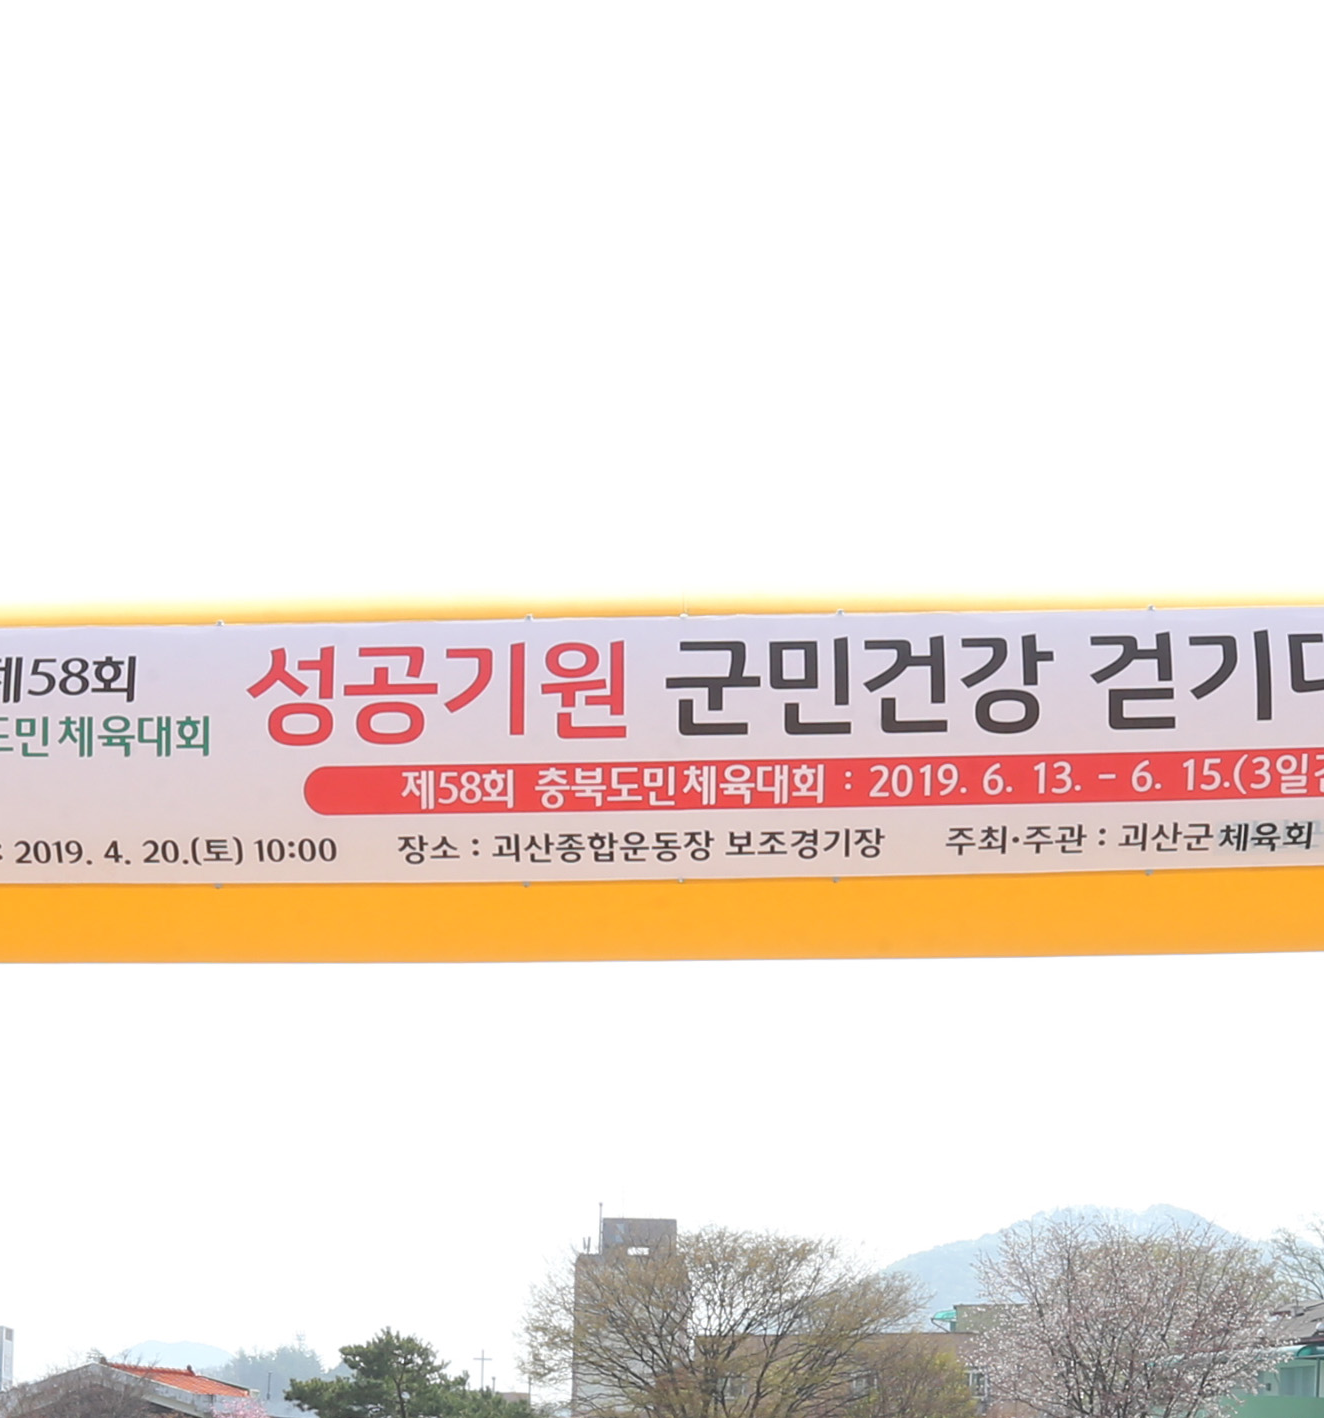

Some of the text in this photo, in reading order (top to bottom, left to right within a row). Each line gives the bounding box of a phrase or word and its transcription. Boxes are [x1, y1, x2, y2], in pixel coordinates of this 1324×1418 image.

[247, 640, 627, 747] 성공기원
[665, 632, 1055, 736] 군민건강
[400, 768, 515, 811] 제58회
[534, 763, 825, 807] 충북도민체육대회
[869, 763, 968, 798] 2019.
[981, 763, 1012, 796] 6.
[1033, 761, 1082, 794] 13.
[1131, 760, 1162, 792] 6.
[15, 839, 93, 866] 2019.
[104, 840, 132, 866] 4.
[252, 837, 337, 863] 10:00
[397, 833, 461, 865] 장소
[492, 832, 714, 865] 괴산종합운동장
[725, 828, 885, 861] 보조경기장
[946, 824, 1087, 857] 주최·주관
